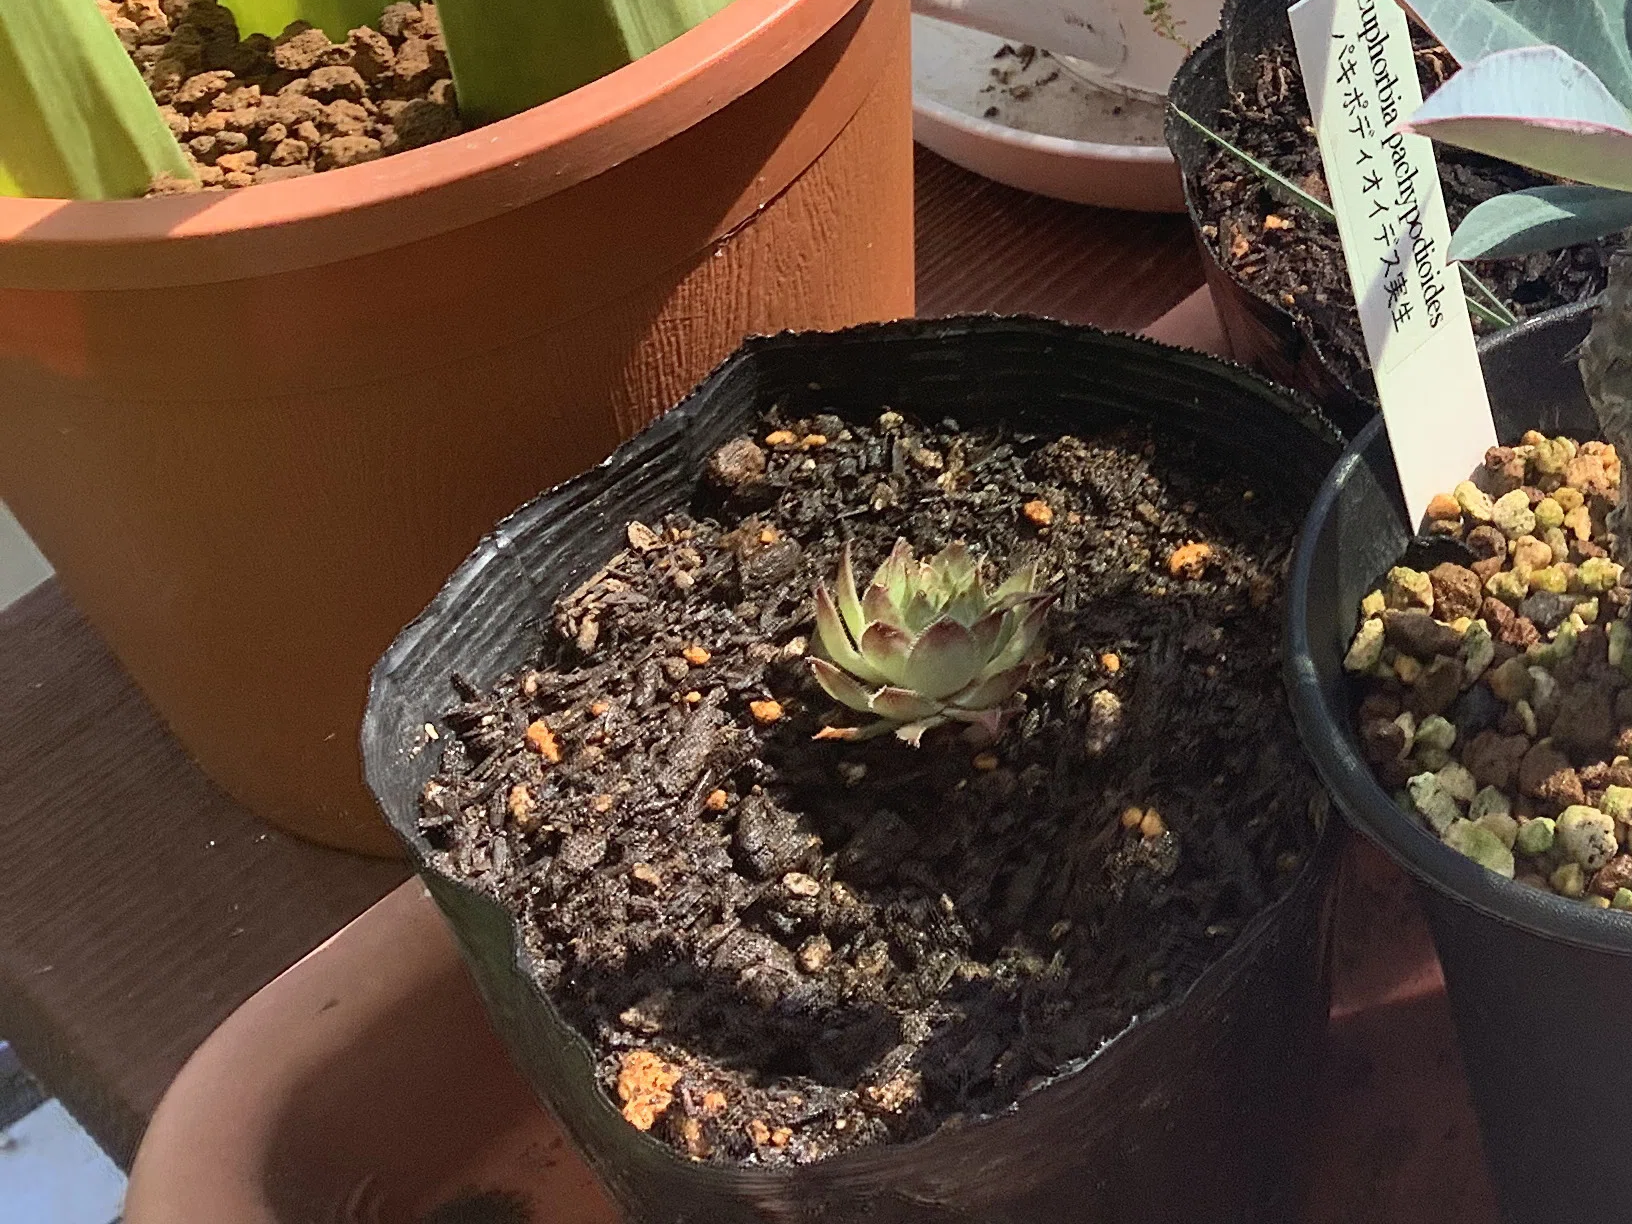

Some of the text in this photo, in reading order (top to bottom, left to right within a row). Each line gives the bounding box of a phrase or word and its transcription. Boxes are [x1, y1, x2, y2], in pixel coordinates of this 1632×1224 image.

[1331, 33, 1412, 334] パキポディオイデス実生
[1380, 130, 1446, 330] pachypodioides
